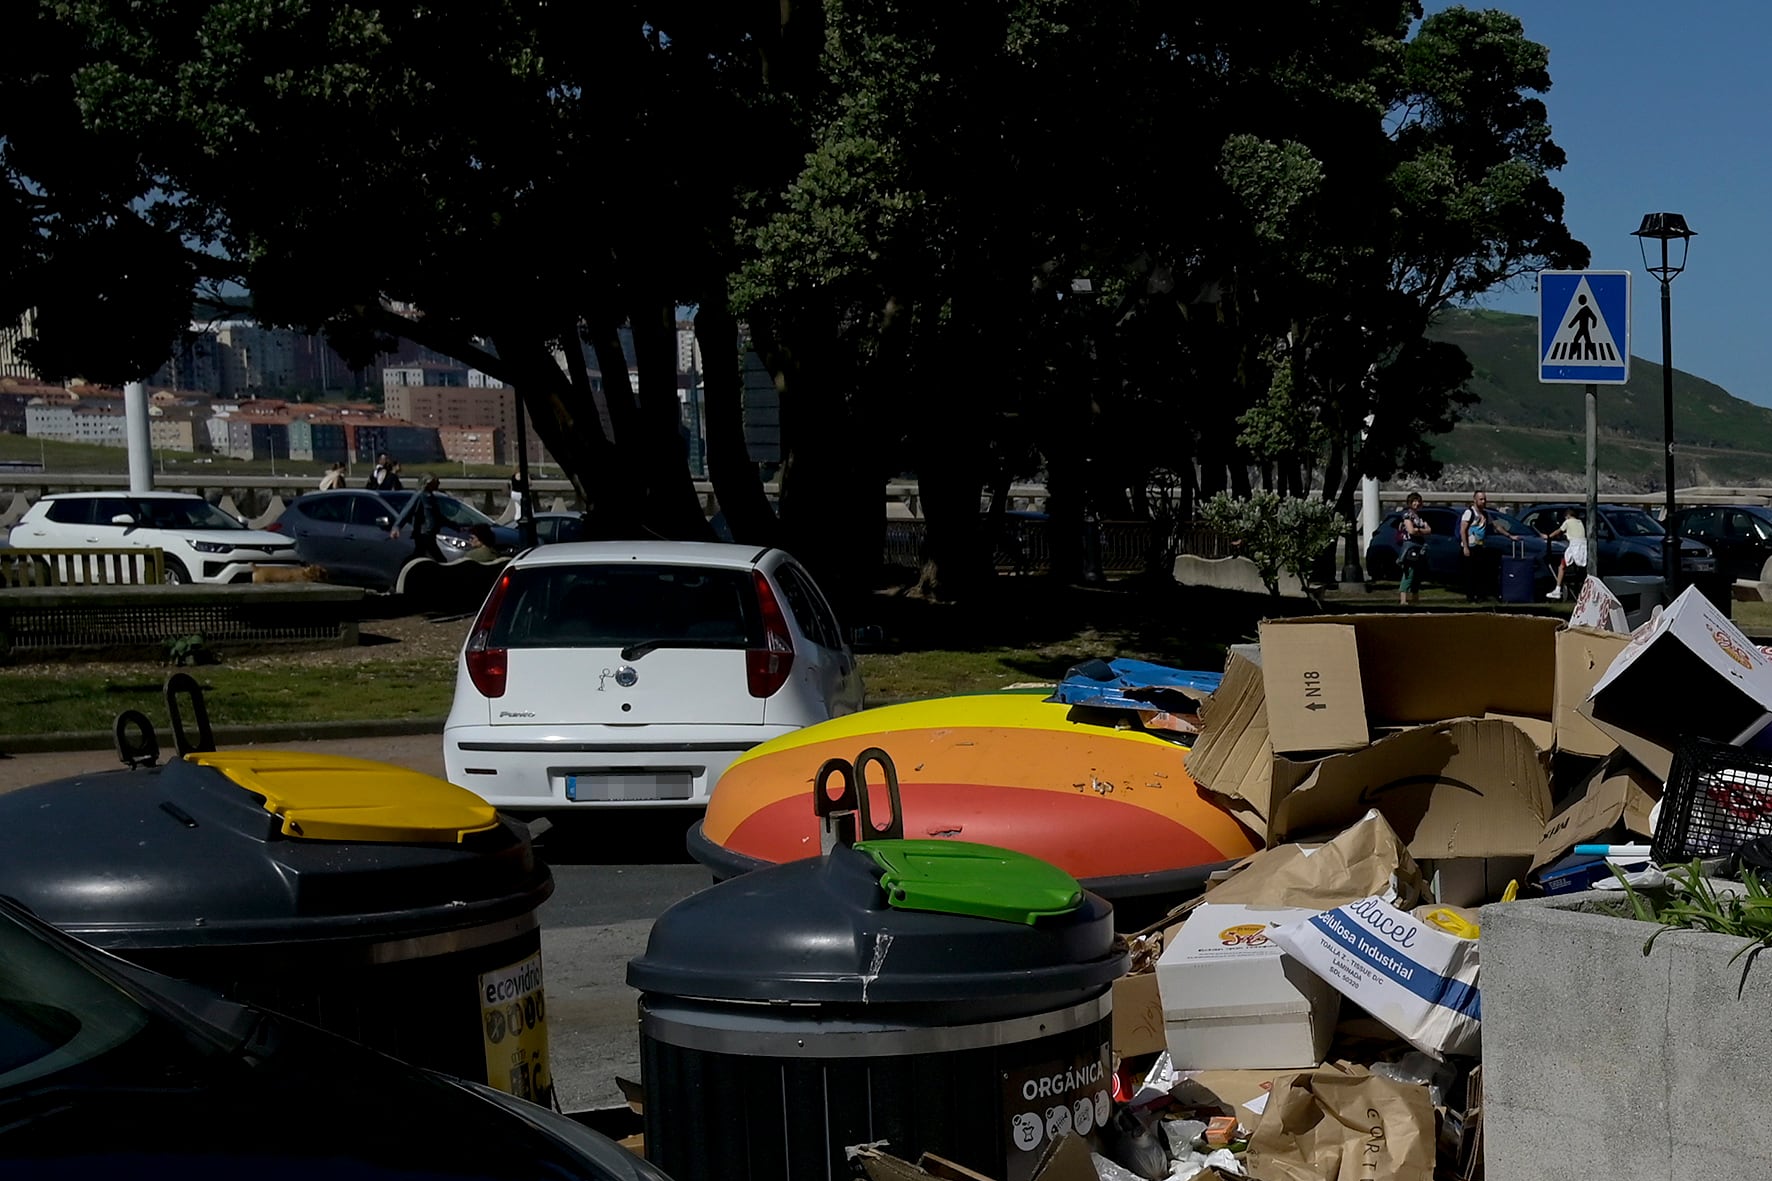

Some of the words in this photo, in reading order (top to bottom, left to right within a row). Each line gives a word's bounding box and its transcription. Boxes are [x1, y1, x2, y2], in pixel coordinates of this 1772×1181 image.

[1304, 671, 1322, 697] N18
[1320, 938, 1341, 956] TOALLA
[1351, 960, 1371, 978] TISSUE
[1372, 974, 1384, 985] D/C
[1332, 959, 1362, 981] LAMINADA
[1357, 937, 1413, 980] Industrial
[486, 962, 540, 1003] ecovidrio
[1023, 1061, 1104, 1100] ORGÁNICA
